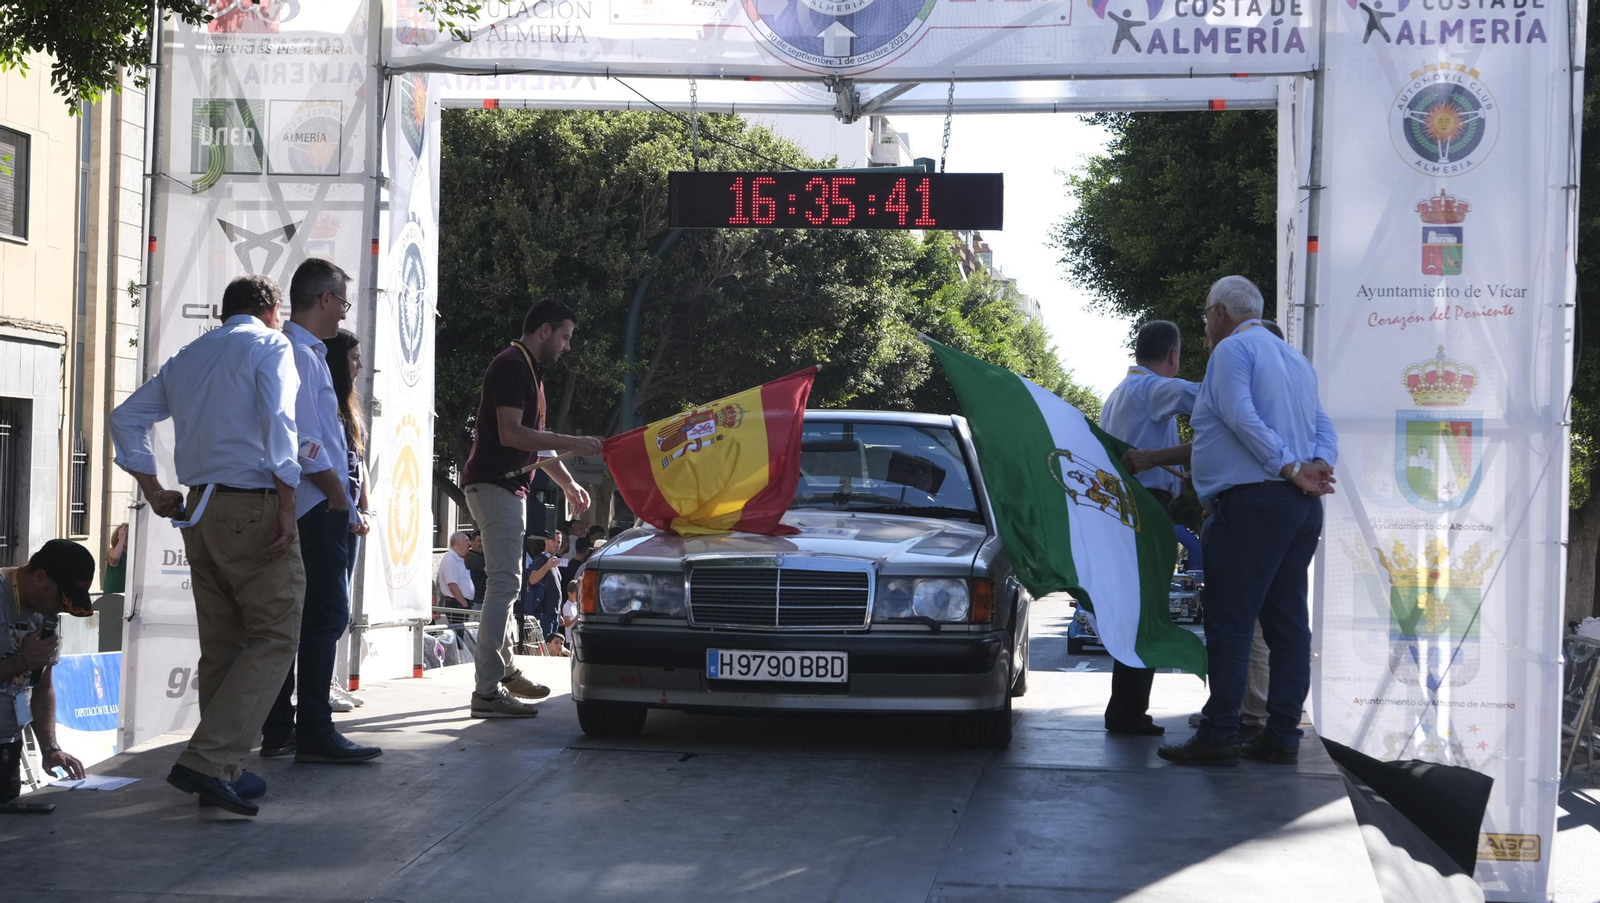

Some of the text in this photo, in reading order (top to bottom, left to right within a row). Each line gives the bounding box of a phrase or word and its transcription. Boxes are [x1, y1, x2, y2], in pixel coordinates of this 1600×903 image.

[1174, 0, 1304, 18] COSTA DE
[487, 20, 589, 44] ALMERÍA
[1146, 18, 1306, 55] ALMERÍA
[1395, 10, 1548, 46] ALMERÍA
[766, 32, 777, 42] 30
[777, 40, 787, 50] de
[857, 47, 889, 63] octubre
[889, 32, 909, 49] 2023
[1469, 82, 1494, 111] CLUB
[282, 132, 327, 143] ALMERÍA
[1414, 160, 1474, 174] ALMERIA
[729, 177, 936, 226] 16:35:41
[1356, 284, 1528, 301] Ayuntamiento de Vícar
[1367, 304, 1515, 331] Corazón del Poniente
[1371, 522, 1435, 532] Ayuntamiento
[1353, 697, 1416, 707] Ayuntamiento
[1467, 700, 1479, 709] de
